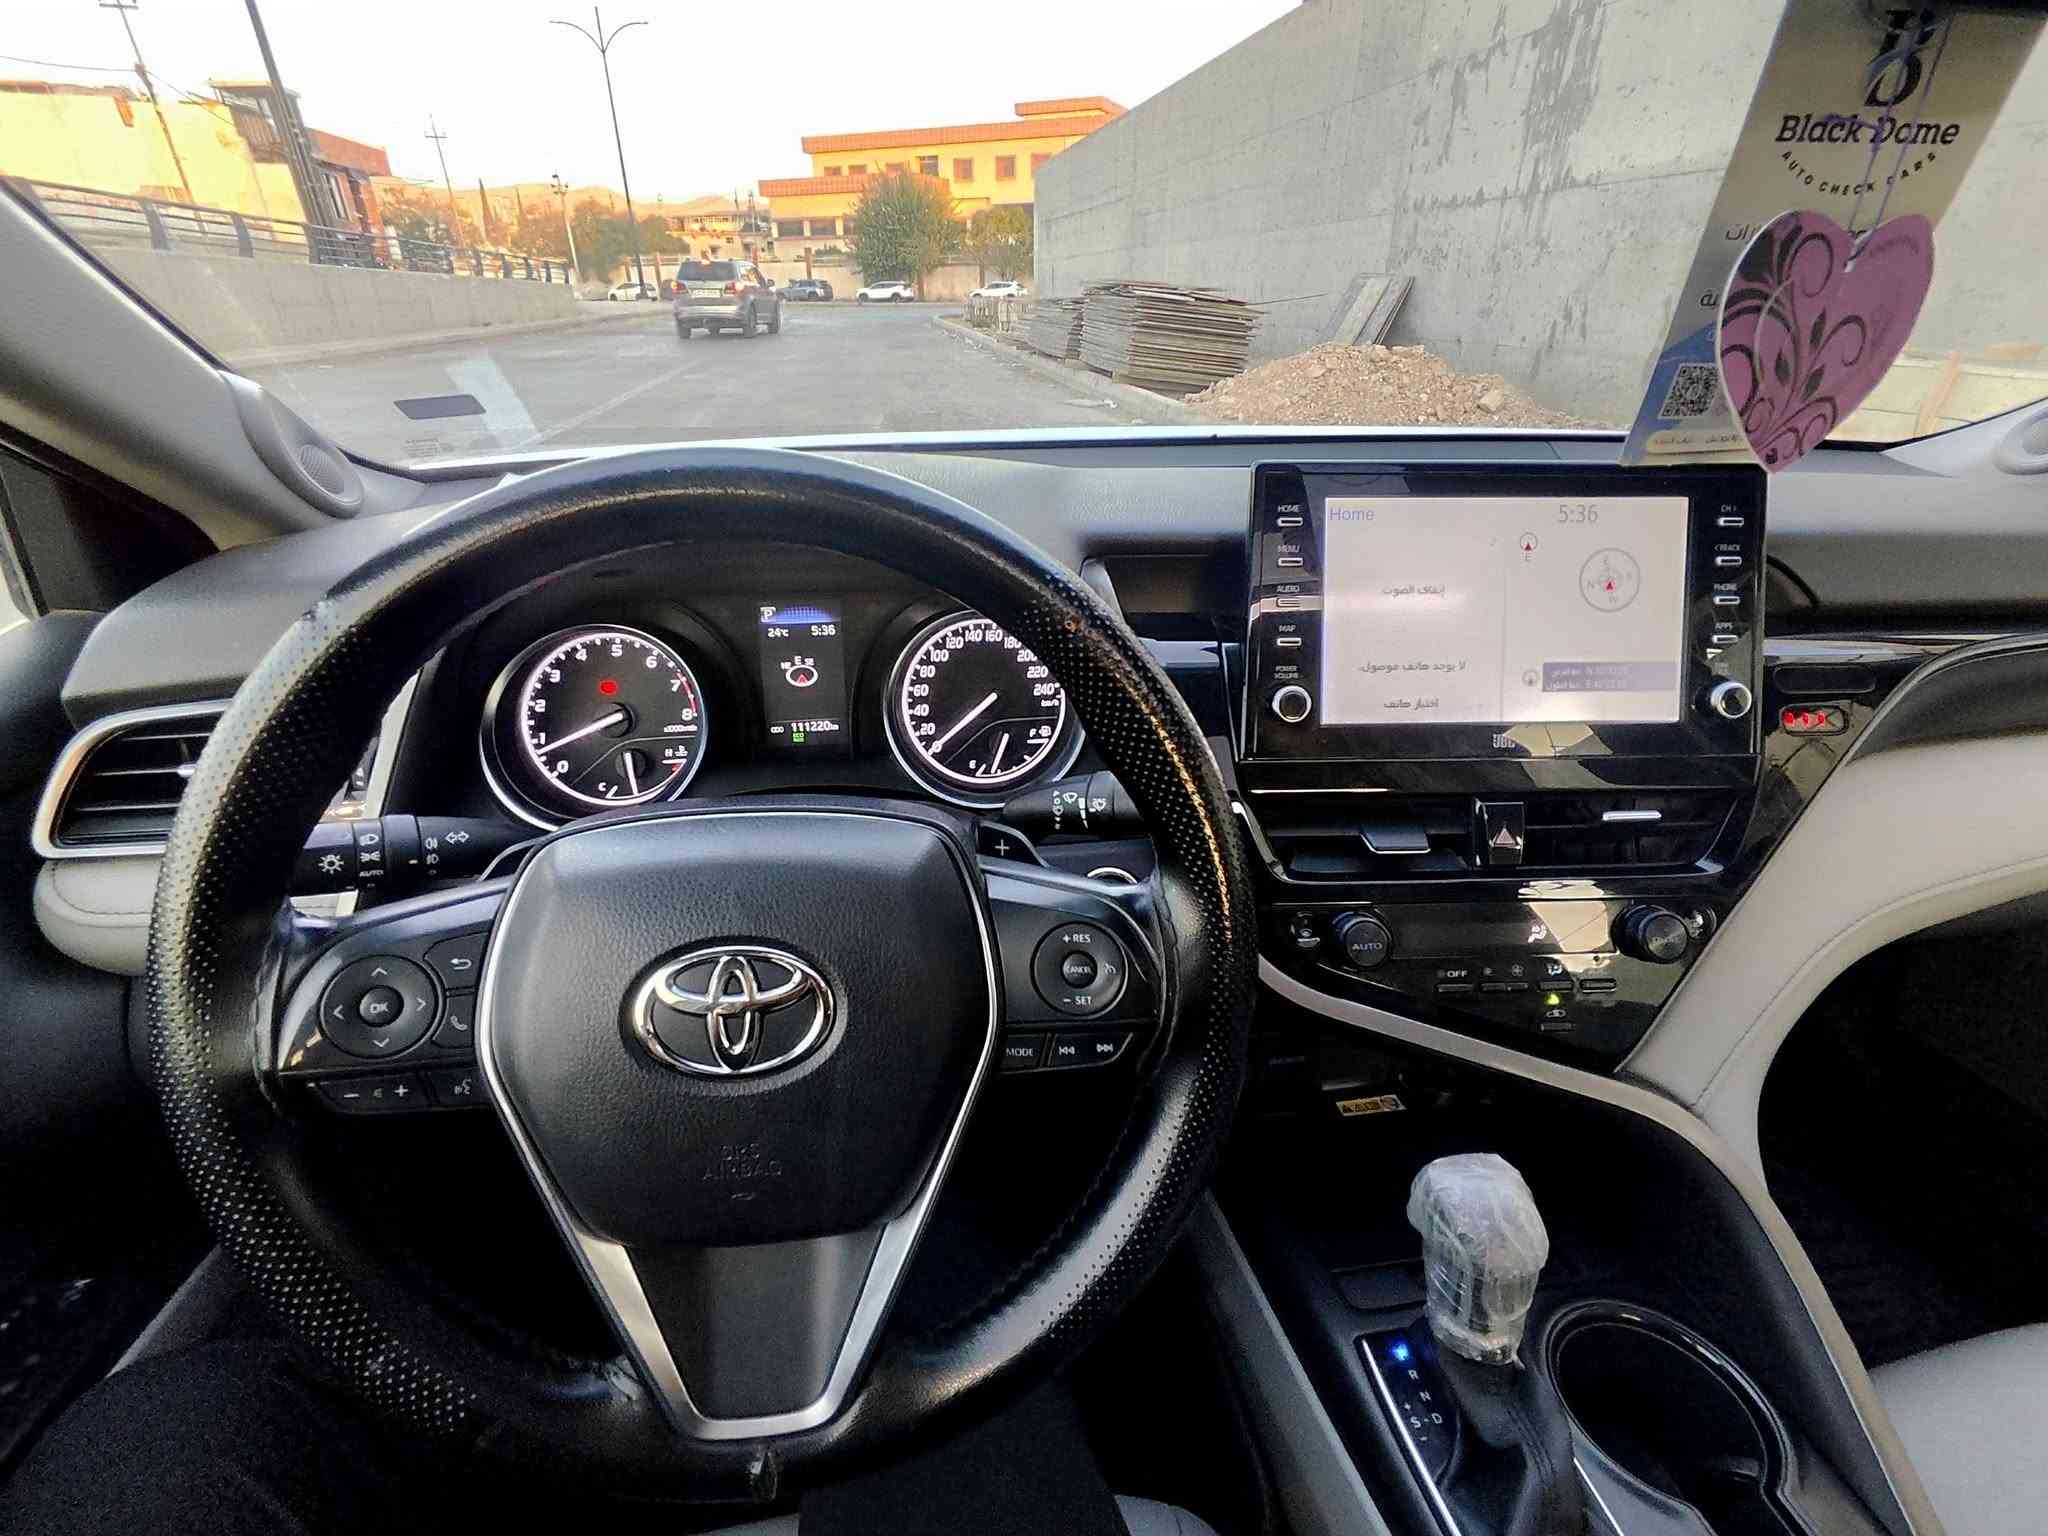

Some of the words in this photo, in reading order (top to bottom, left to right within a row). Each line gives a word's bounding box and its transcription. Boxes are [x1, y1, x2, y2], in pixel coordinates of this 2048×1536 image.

[1775, 113, 1861, 143] Black
[1869, 115, 1960, 145] Dome
[1781, 151, 1814, 186] AUTO
[1819, 181, 1876, 197] CHECK
[1277, 505, 1301, 513] HOME
[1329, 507, 1375, 521] Home
[1558, 504, 1599, 523] 5:36
[1276, 585, 1300, 593] AUDIO
[811, 624, 836, 637] 5:36
[964, 629, 983, 642] 140
[985, 629, 1003, 642] 160
[945, 636, 964, 649] 120
[575, 648, 588, 661] 4
[611, 644, 623, 657] 5
[930, 650, 949, 662] 100
[645, 655, 658, 668] 6
[549, 669, 561, 683] 3
[919, 665, 936, 678] 80
[1027, 665, 1049, 679] 220
[669, 679, 681, 692] 7
[913, 684, 929, 697] 60
[1033, 683, 1055, 696] 240
[534, 699, 546, 713] 2
[913, 703, 930, 716] 40
[681, 708, 693, 721] 8
[919, 722, 936, 735] 20
[538, 732, 546, 745] 1
[556, 760, 569, 774] 0
[1351, 942, 1383, 951] AUTO
[1447, 969, 1468, 979] OFF
[368, 1002, 390, 1014] OK
[1005, 1047, 1034, 1057] MODE
[1410, 1416, 1422, 1428] S
[1431, 1412, 1443, 1425] D
